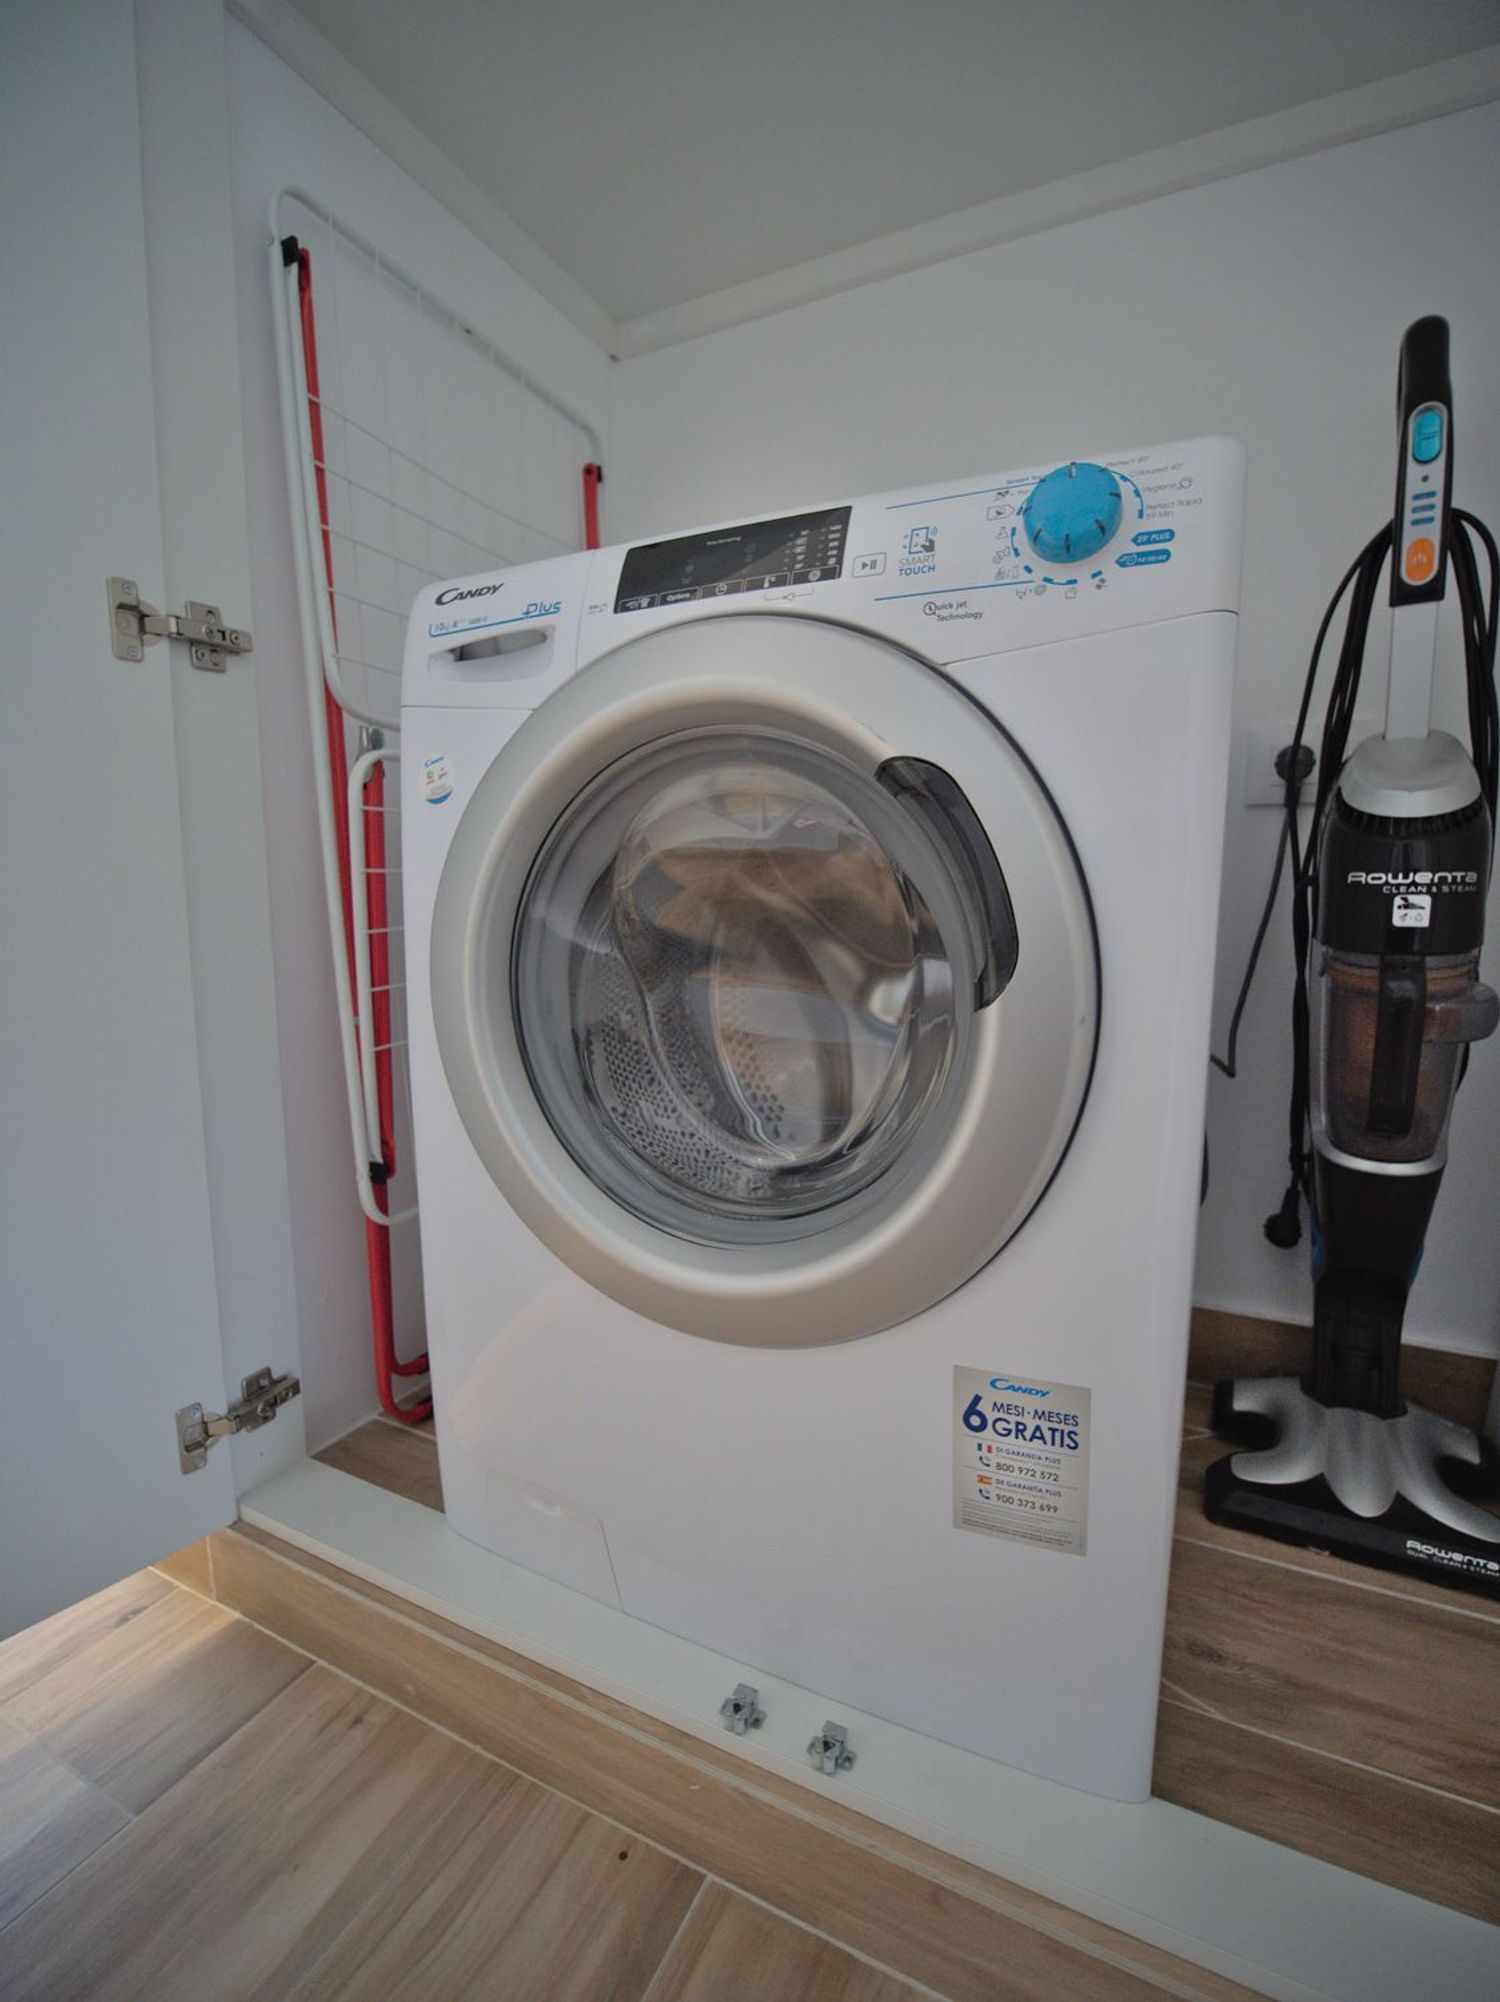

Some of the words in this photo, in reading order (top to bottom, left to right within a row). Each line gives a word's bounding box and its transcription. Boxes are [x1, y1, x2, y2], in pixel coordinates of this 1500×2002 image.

[899, 554, 936, 565] SMART
[899, 564, 936, 576] TOUCH
[956, 601, 969, 611] jet
[937, 610, 984, 622] Technology
[1382, 885, 1428, 894] CLEAN
[963, 1393, 989, 1434] 6
[991, 1401, 1025, 1418] MESI
[1032, 1408, 1080, 1427] MESES
[992, 1417, 1080, 1451] GRATIS
[1044, 1456, 1062, 1465] PLUS
[995, 1462, 1015, 1473] 800
[1017, 1466, 1037, 1479] 972
[1039, 1471, 1060, 1483] 572
[1045, 1489, 1063, 1498] PLUS
[995, 1493, 1015, 1505] 900
[1016, 1498, 1036, 1510] 373
[1039, 1502, 1059, 1514] 699
